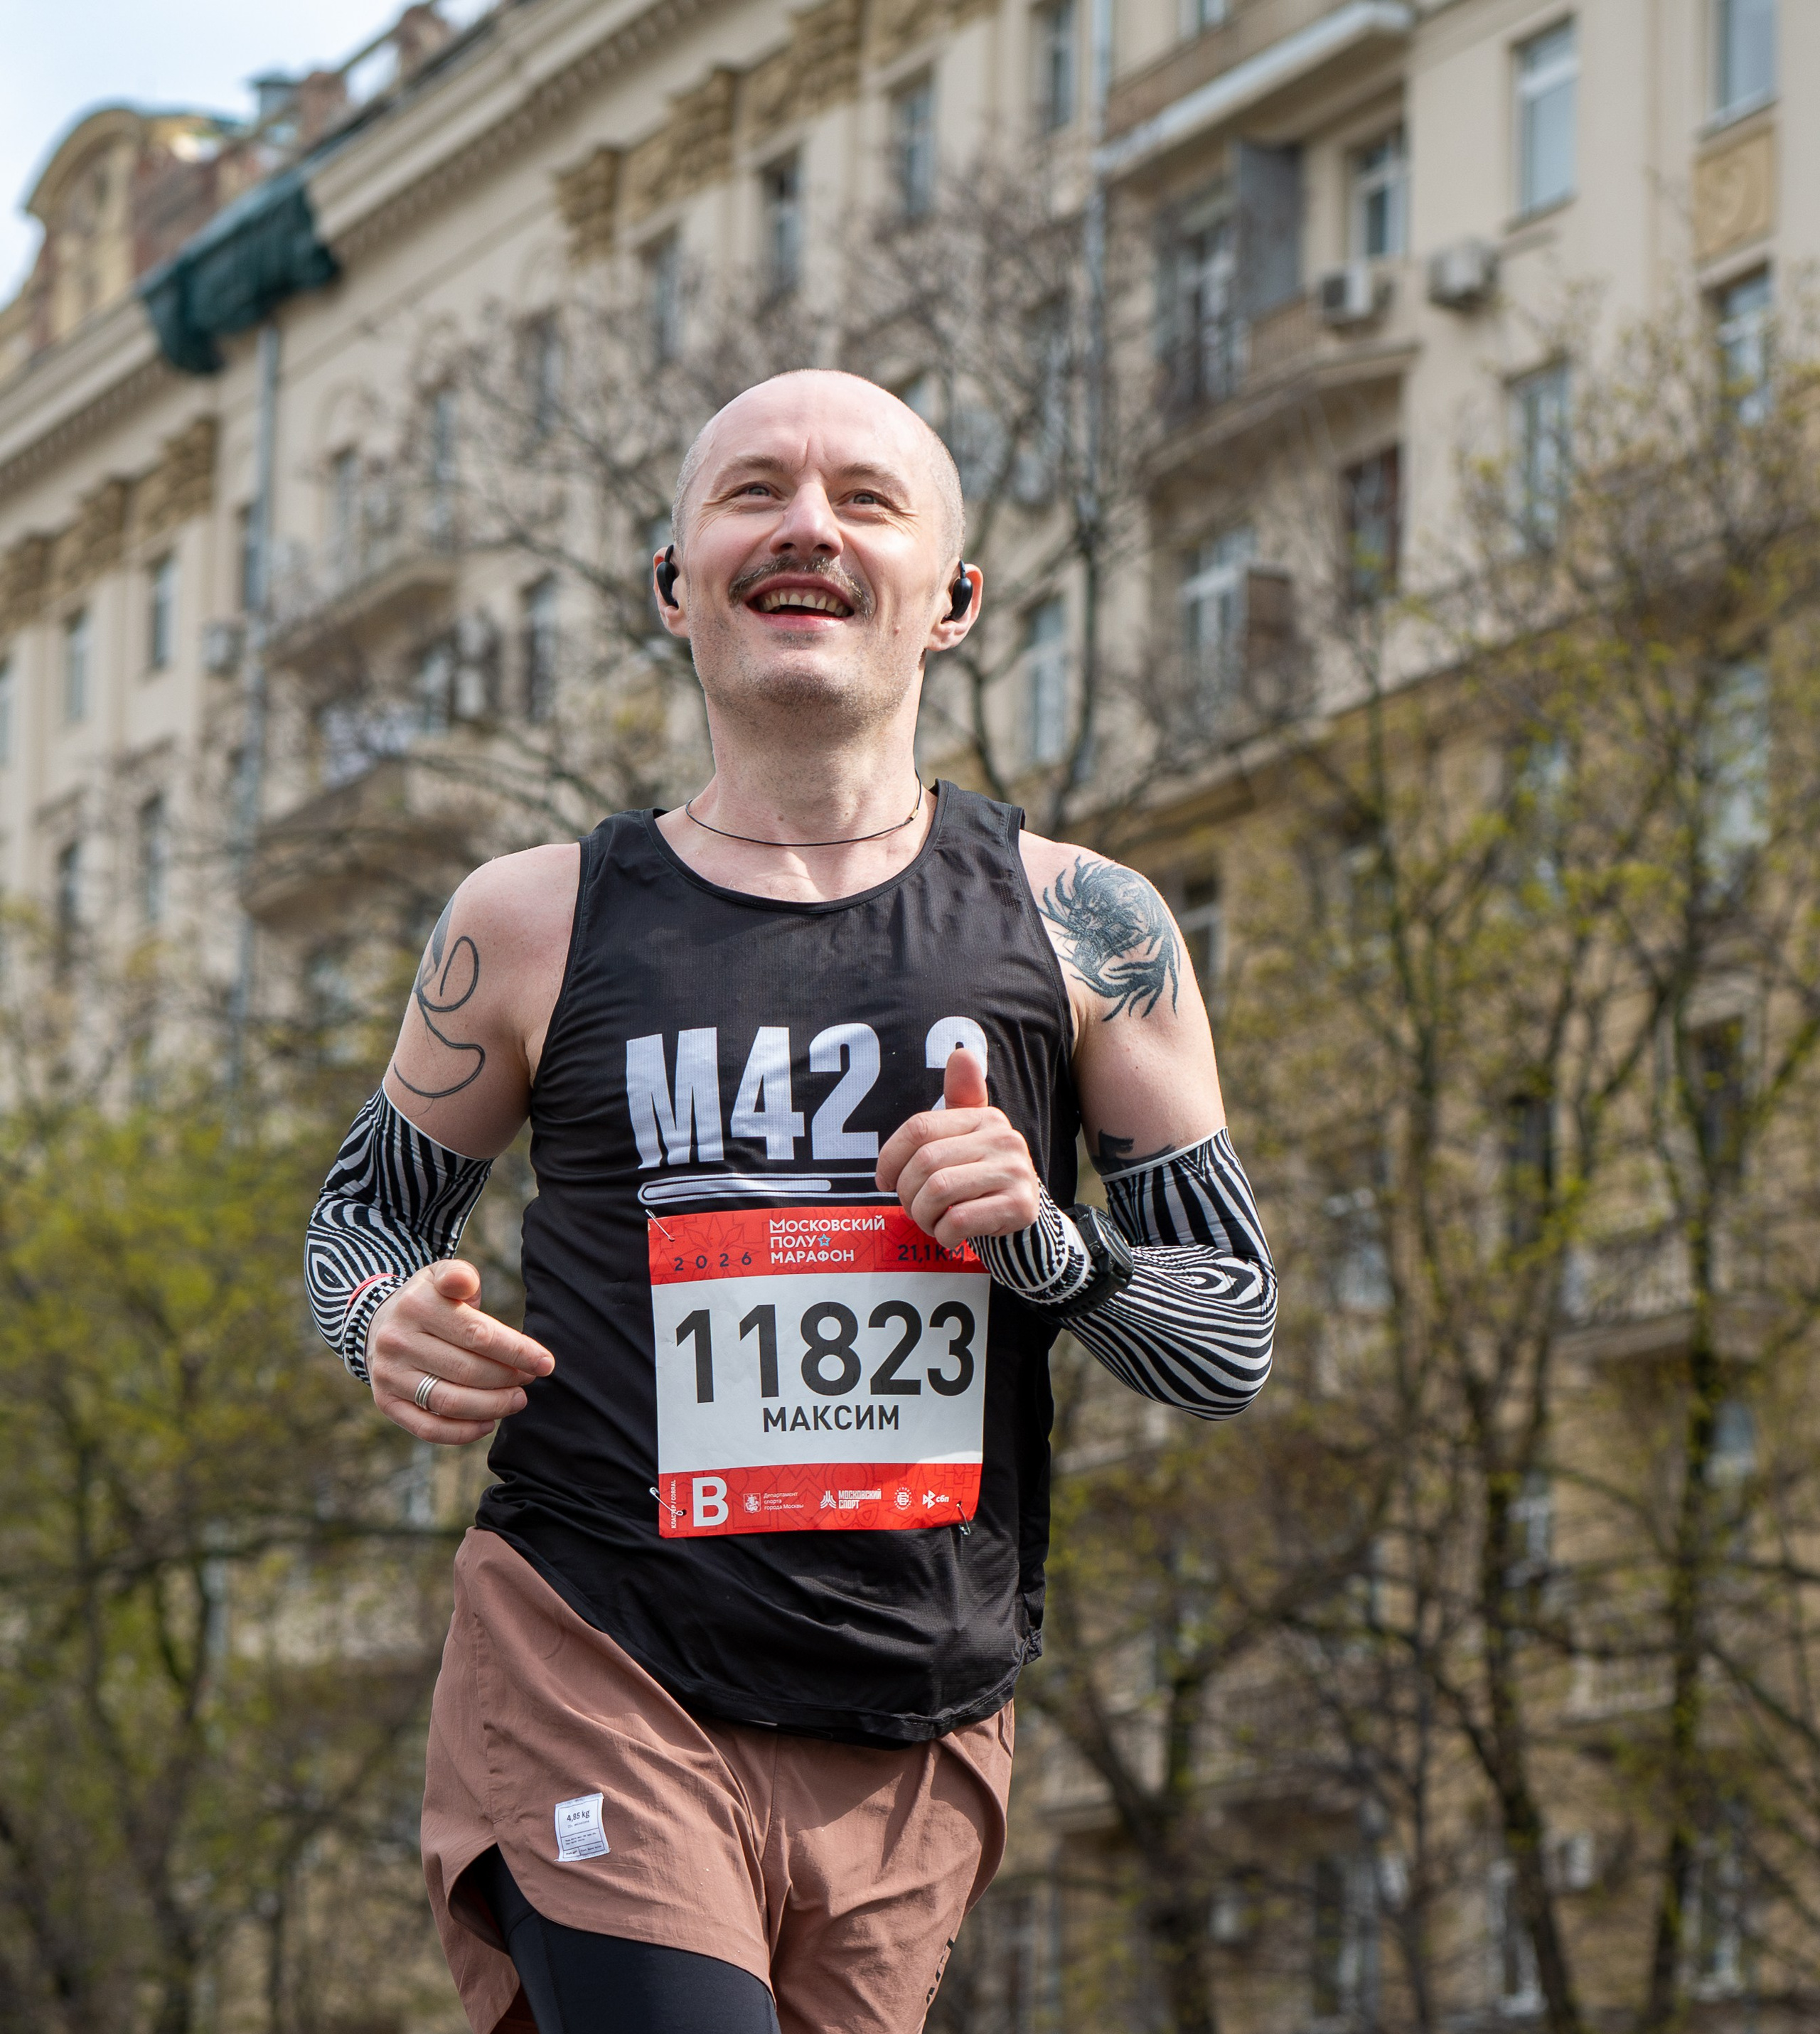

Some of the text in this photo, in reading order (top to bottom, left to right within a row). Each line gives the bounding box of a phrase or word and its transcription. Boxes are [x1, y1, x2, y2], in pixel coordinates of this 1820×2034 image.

[769, 1215, 885, 1233] МОСКОВСКИЙ
[770, 1235, 817, 1249] ПОЛУ
[674, 1251, 752, 1271] 2026
[771, 1249, 855, 1264] МАРАФОН
[675, 1300, 975, 1403] 11823
[764, 1404, 899, 1433] МАКСИМ
[692, 1476, 728, 1527] B
[838, 1488, 882, 1499] МОСКОВСКИЙ
[838, 1499, 860, 1509] СПОРТ
[582, 1809, 590, 1819] kg
